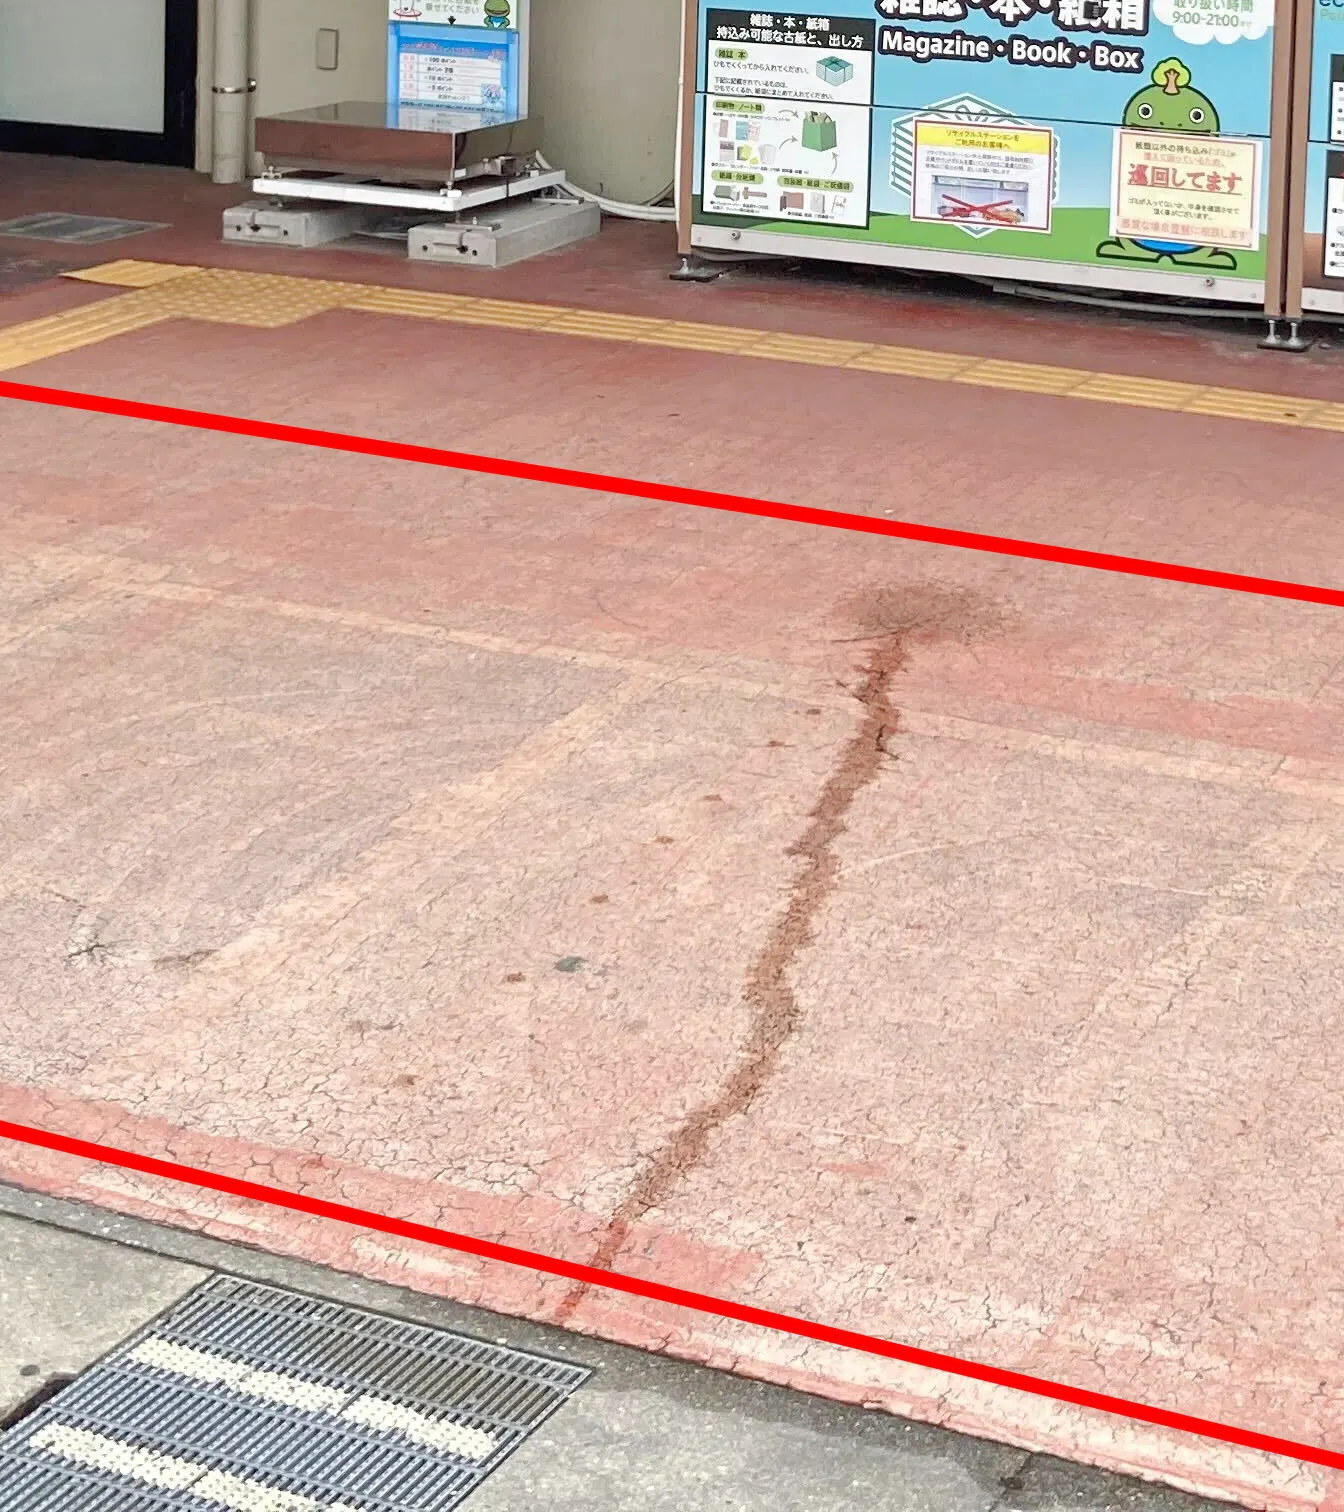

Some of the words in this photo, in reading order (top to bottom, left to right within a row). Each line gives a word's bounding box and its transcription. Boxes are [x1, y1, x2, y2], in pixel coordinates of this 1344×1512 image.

[750, 13, 830, 32] 雑誌・本・紙箱
[716, 25, 864, 49] 持込み可能な古紙と、出し方
[1128, 163, 1243, 193] 巡回してます
